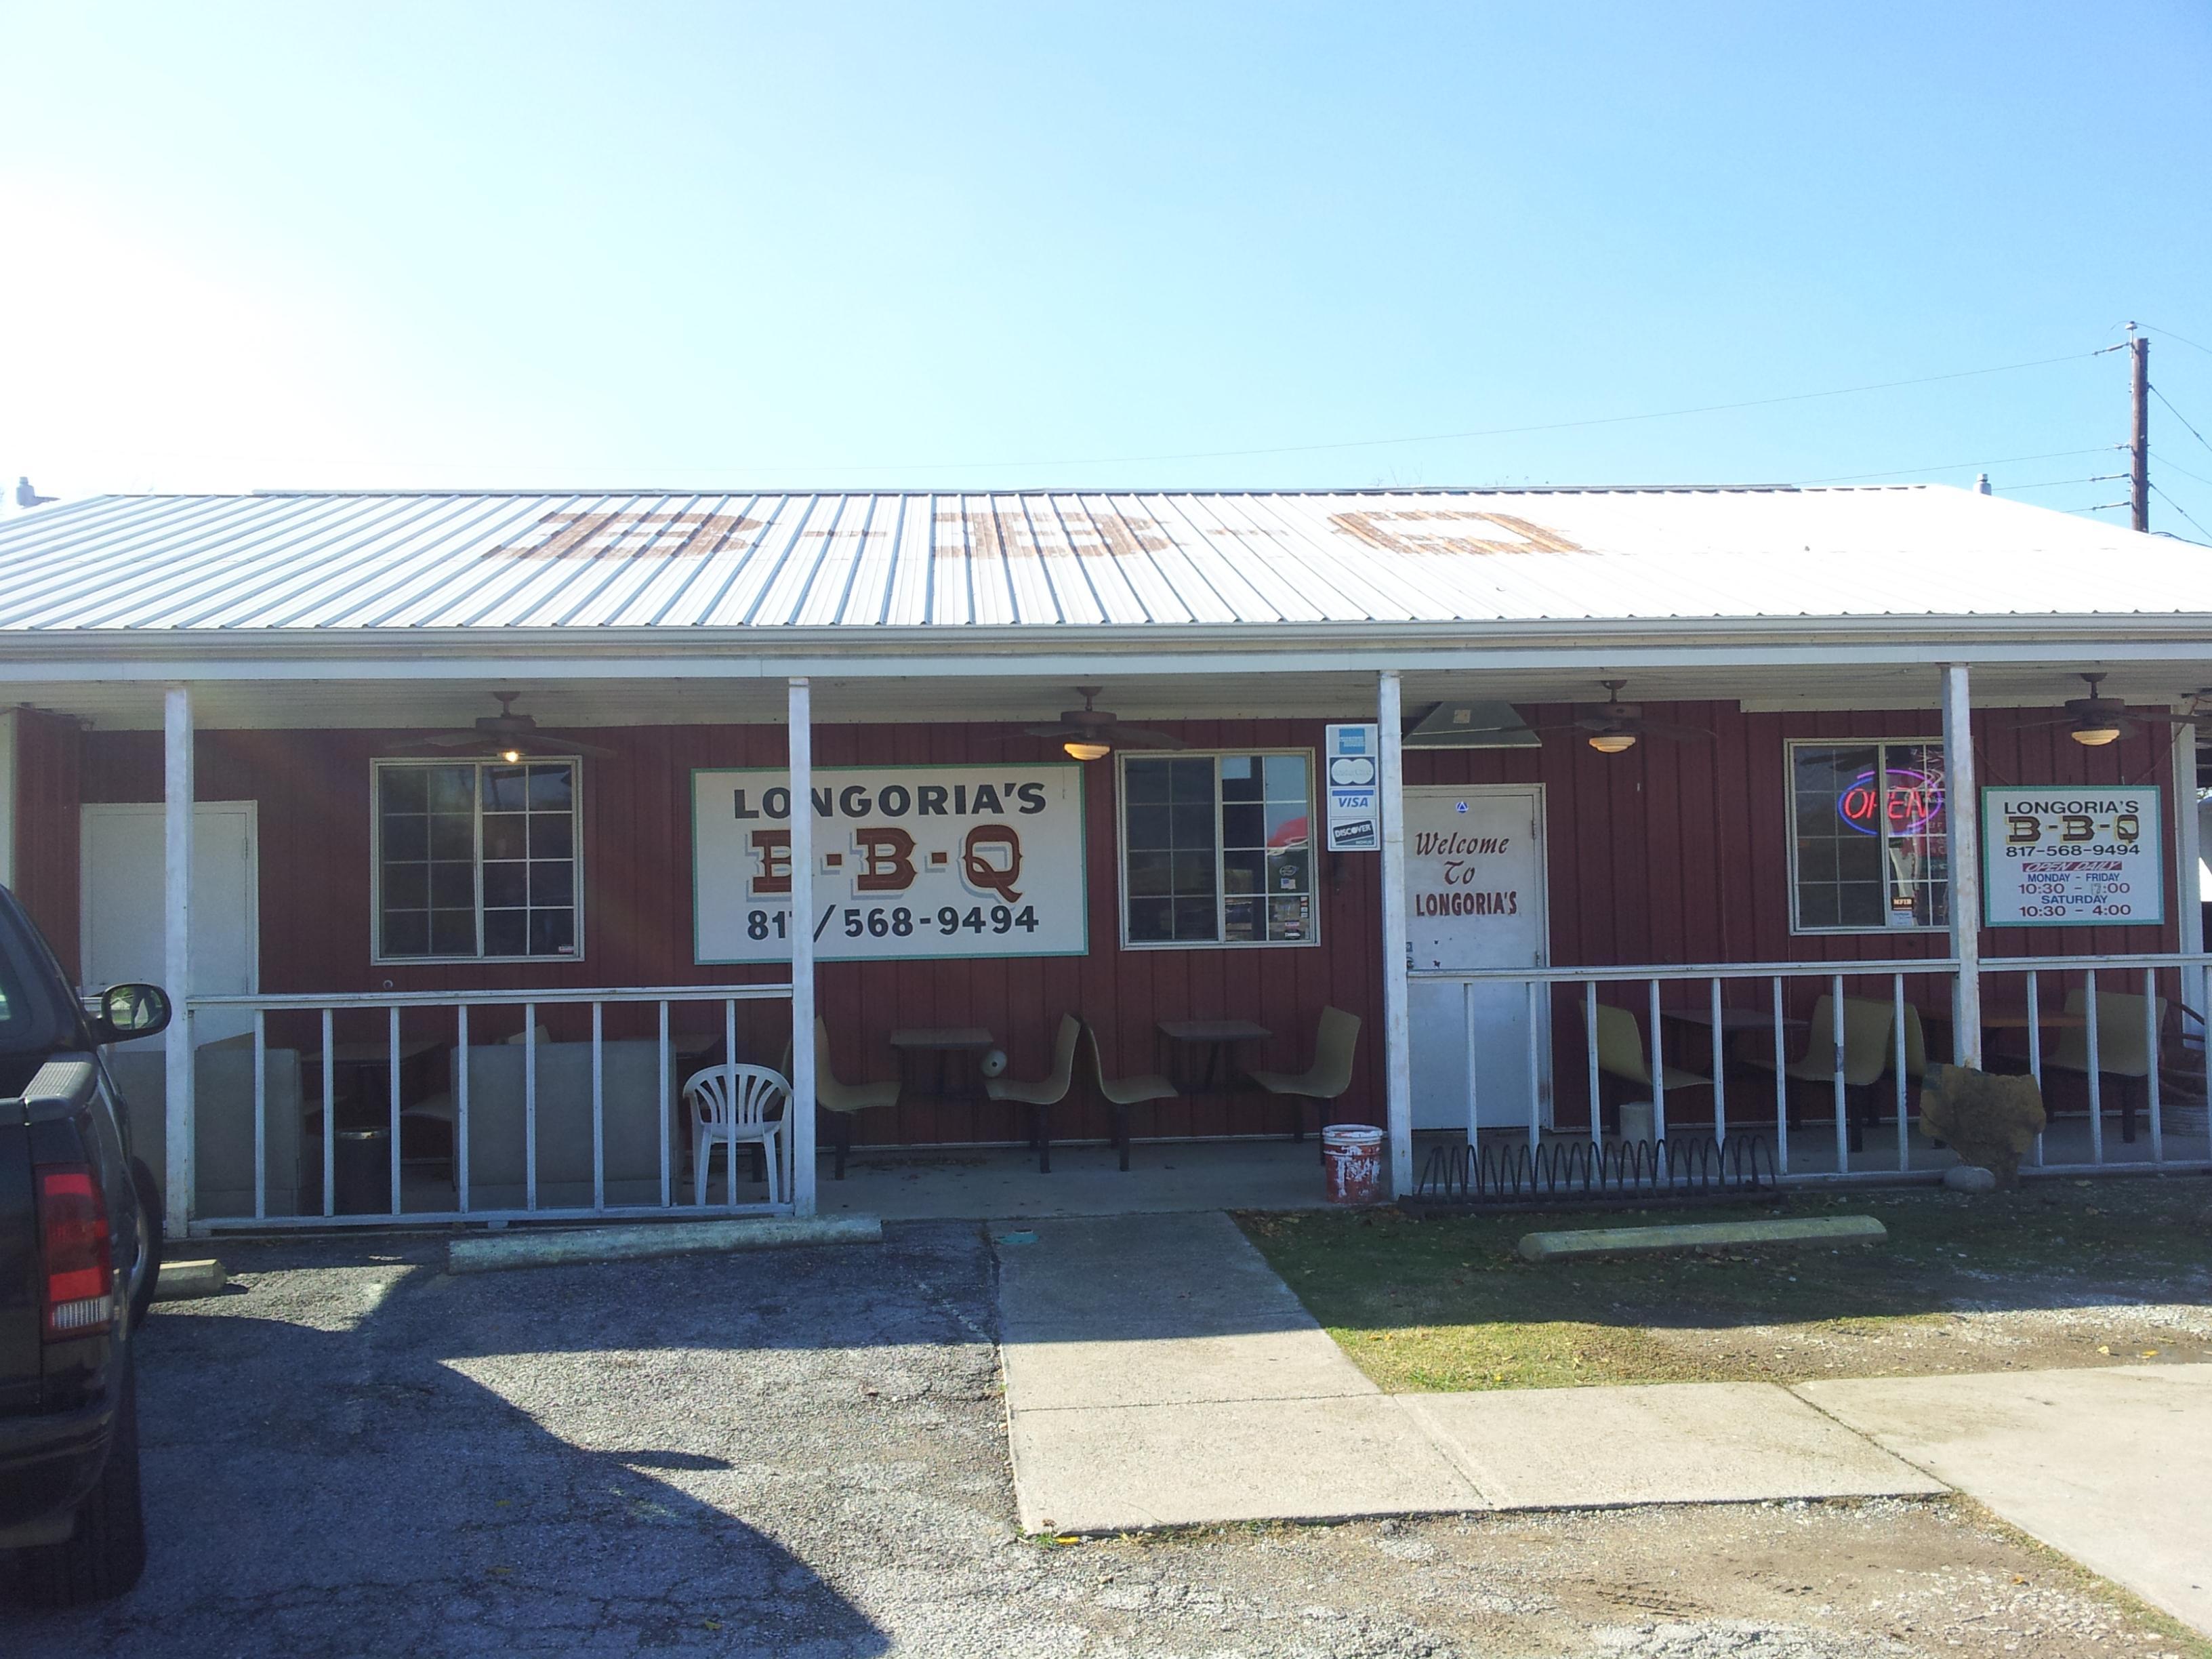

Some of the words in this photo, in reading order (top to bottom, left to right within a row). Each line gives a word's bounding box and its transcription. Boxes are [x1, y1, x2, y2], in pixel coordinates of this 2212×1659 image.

[734, 782, 1046, 819] LONGORIA'S
[1338, 797, 1368, 808] VISA
[1845, 787, 1926, 819] OPEN
[2004, 800, 2139, 814] LONGORIA'S
[1334, 823, 1372, 838] DISCOVER
[2007, 815, 2139, 844] B-B-Q
[1415, 832, 1510, 855] Welcome
[2006, 844, 2140, 857] 817-568-9494
[1443, 860, 1475, 885] To
[2026, 862, 2070, 872] OPEN
[2074, 861, 2121, 871] DAILY
[2028, 873, 2070, 882] MONDAY
[2086, 873, 2120, 881] FRIDAY
[2018, 883, 2065, 894] 10:30
[1416, 891, 1517, 916] LONGORIA'S
[2041, 895, 2108, 904] SATURDAY
[2019, 905, 2066, 916] 10:30
[2092, 905, 2131, 915] 4:00
[747, 904, 1039, 943] 81/568-9494
